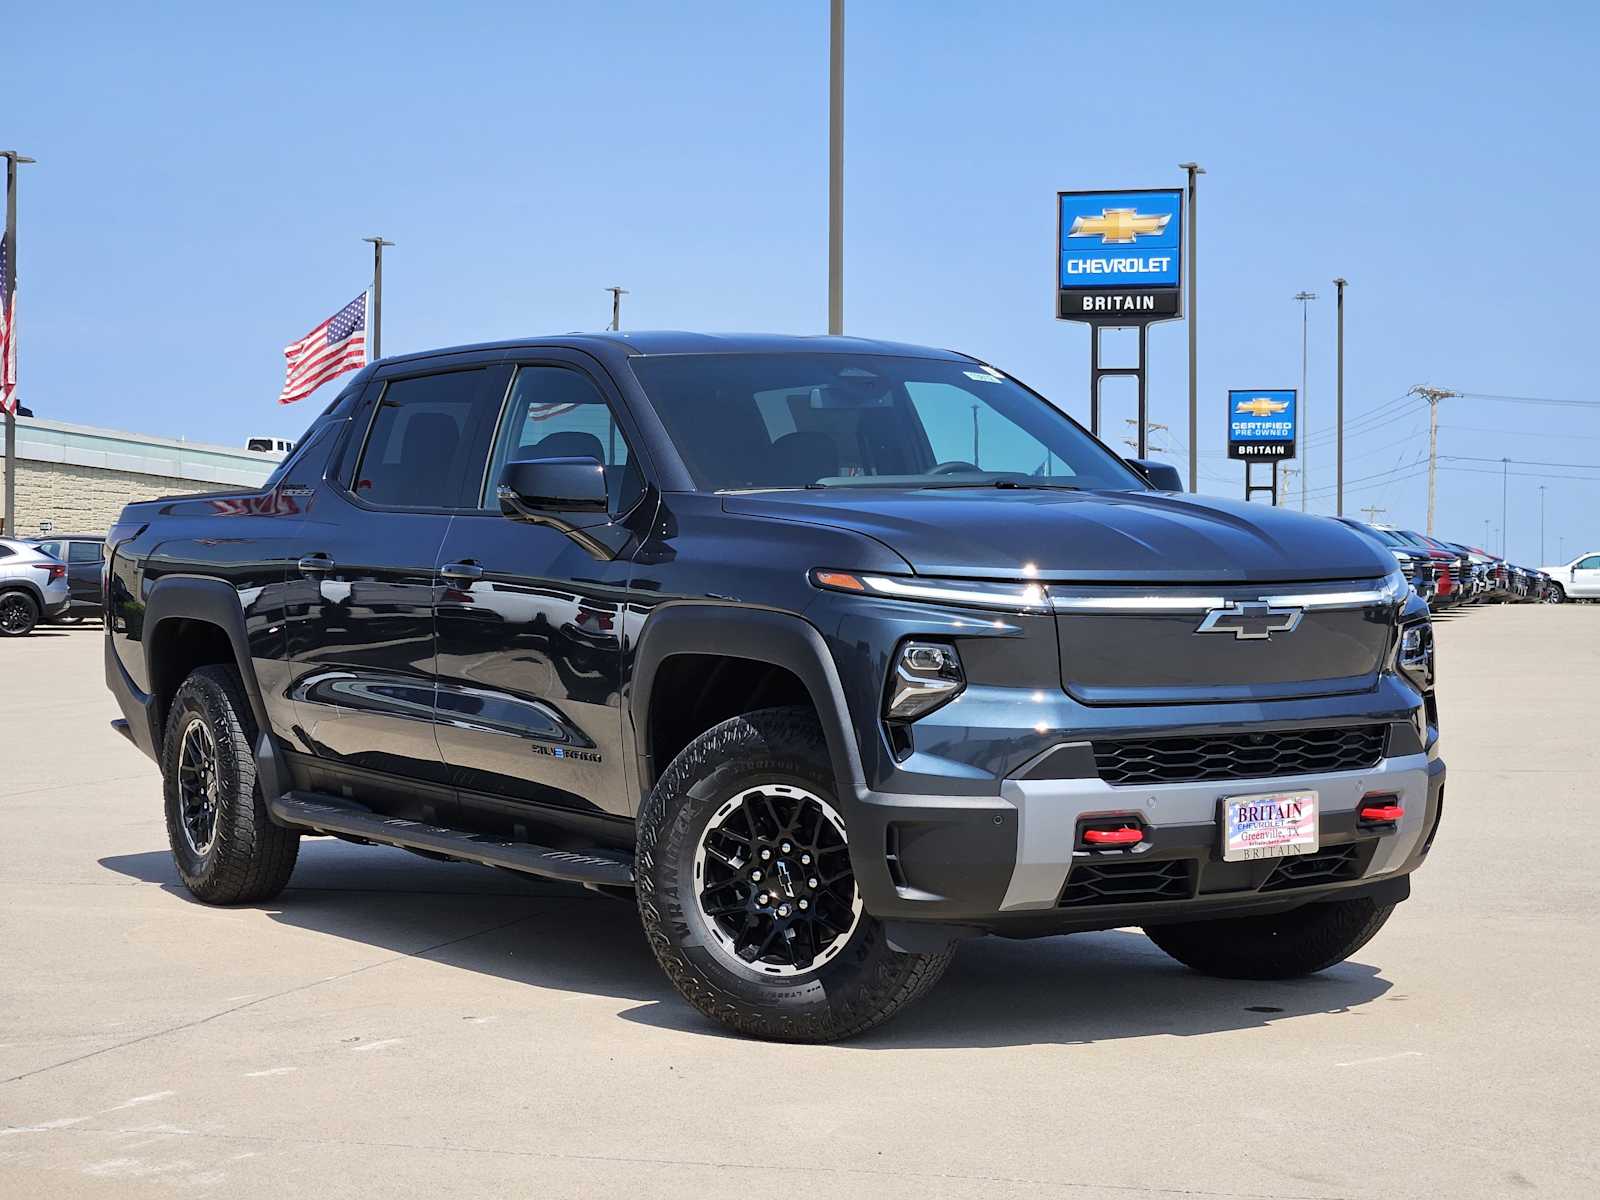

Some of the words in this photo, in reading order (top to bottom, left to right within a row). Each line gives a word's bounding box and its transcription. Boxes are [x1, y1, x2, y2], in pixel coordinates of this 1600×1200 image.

[1067, 257, 1171, 274] CHEVROLET
[1082, 295, 1154, 311] BRITAIN
[1231, 421, 1292, 430] CERTIFIED
[1238, 445, 1285, 455] BRITAIN
[1239, 802, 1302, 822] BRITAIN
[1237, 820, 1285, 831] CHEVROLET
[1287, 825, 1300, 837] TX
[1244, 844, 1301, 859] BRITAIN
